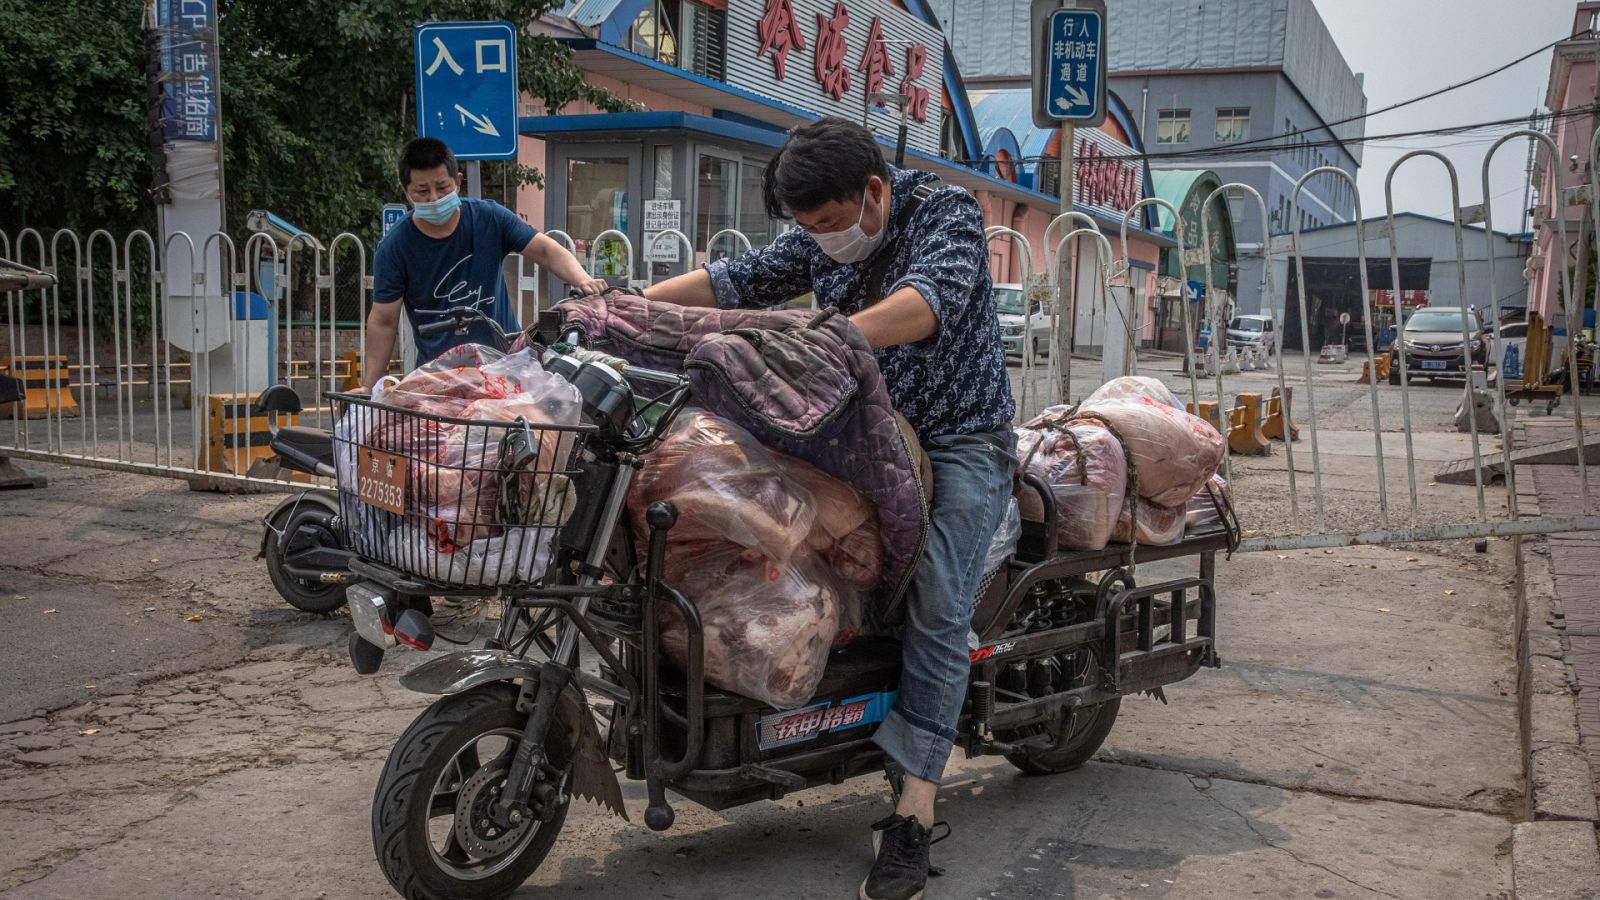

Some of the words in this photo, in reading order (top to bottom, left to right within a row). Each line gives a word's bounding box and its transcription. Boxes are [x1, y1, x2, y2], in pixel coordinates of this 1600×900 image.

[1063, 18, 1089, 38] 行人
[425, 36, 507, 77] 入口
[1054, 40, 1096, 60] 非机动车
[1060, 63, 1088, 82] 通道
[360, 476, 402, 508] 2275353
